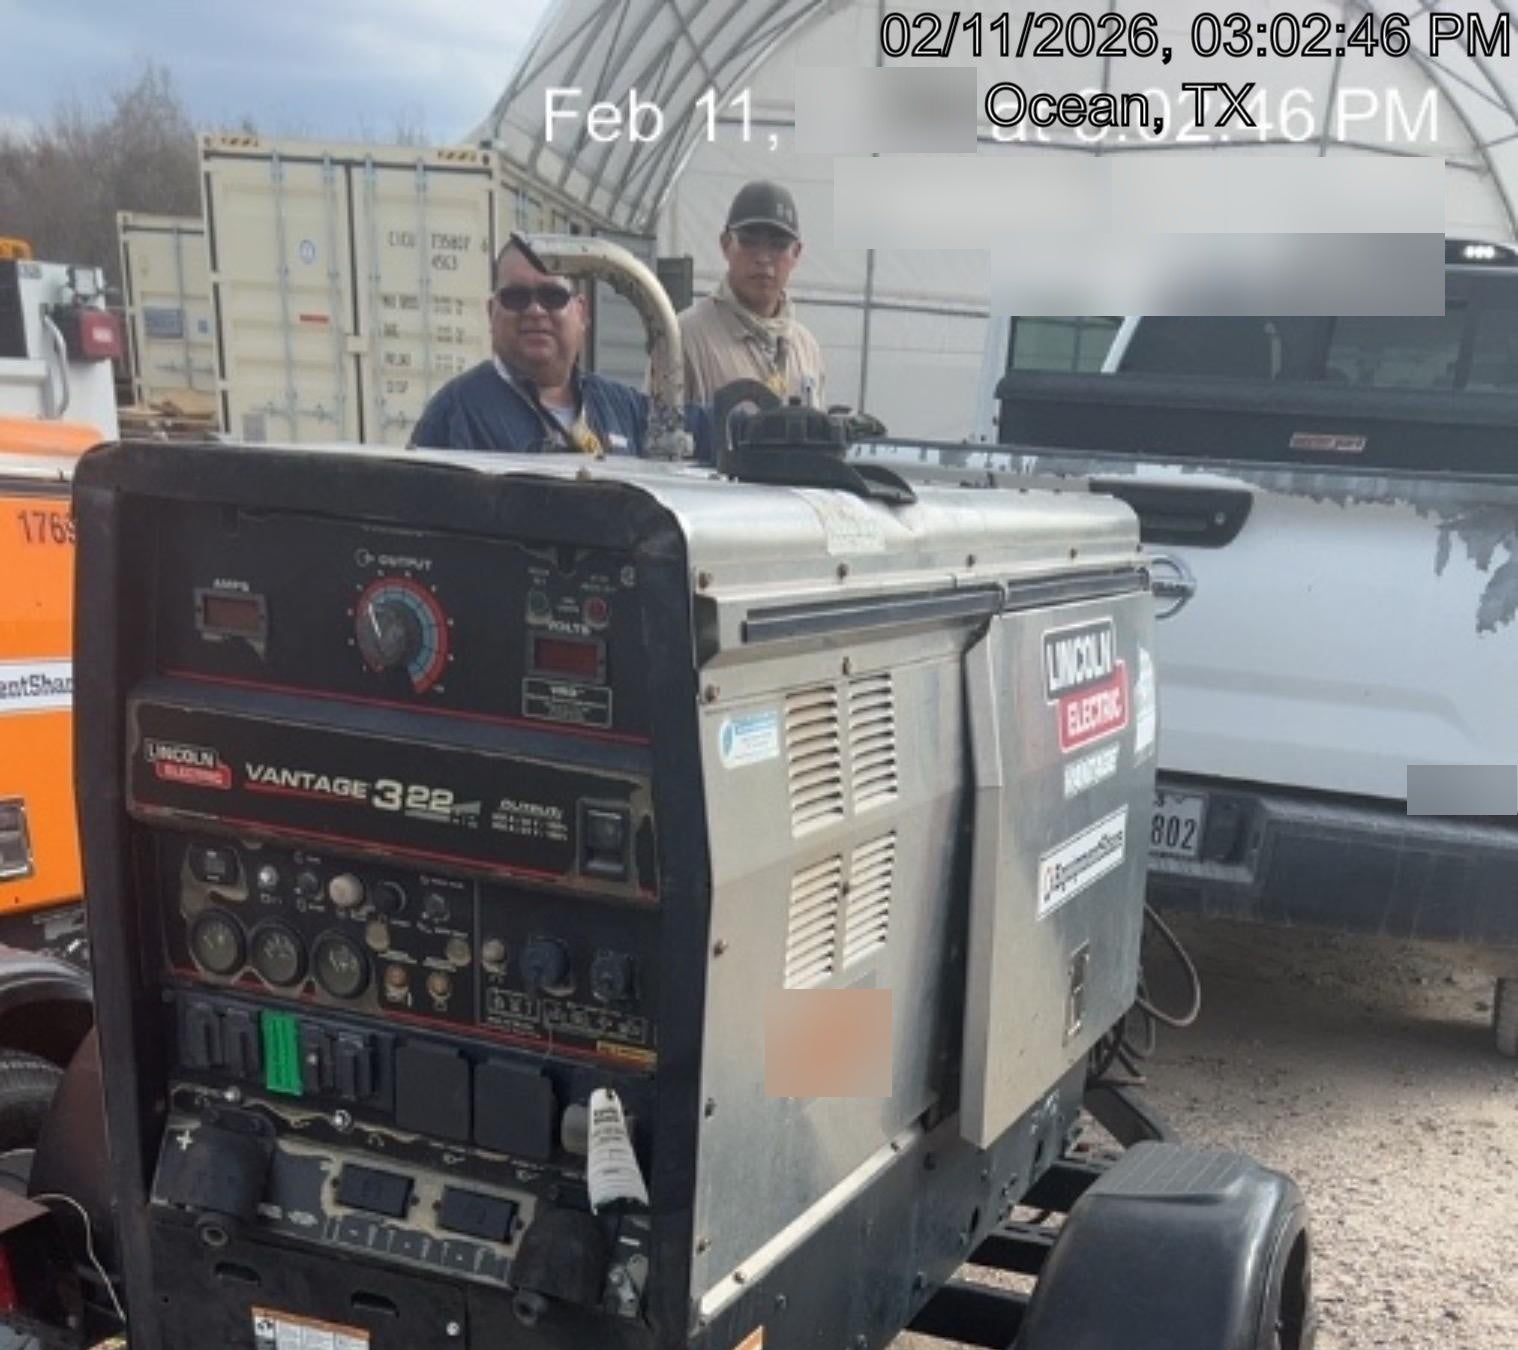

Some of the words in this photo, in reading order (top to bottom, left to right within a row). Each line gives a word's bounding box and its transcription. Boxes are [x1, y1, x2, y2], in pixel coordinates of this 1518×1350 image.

[378, 553, 433, 571] OUTPUT
[213, 578, 251, 592] AMPS
[1046, 629, 1112, 691] LINCOLN
[1067, 686, 1122, 737] ELECTRIC
[149, 743, 215, 768] LINCOLN
[163, 763, 224, 785] ELECTRIC
[245, 762, 368, 799] VANTAGE
[372, 778, 454, 814] 322
[1151, 812, 1197, 851] 802
